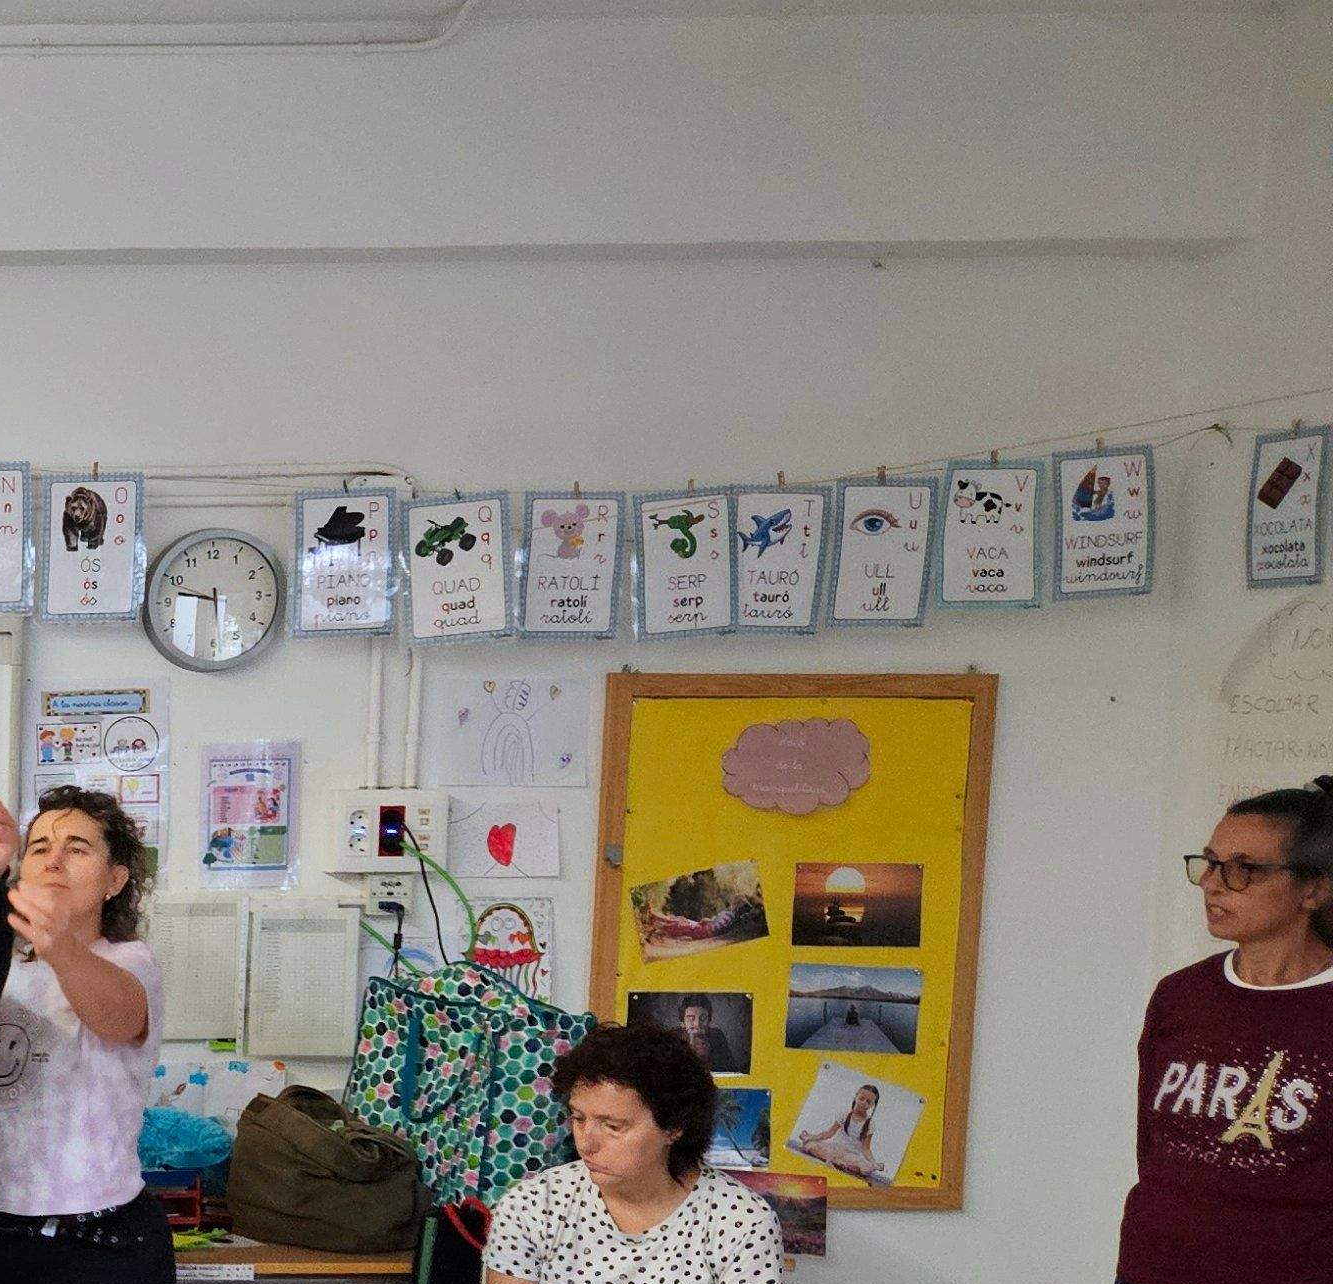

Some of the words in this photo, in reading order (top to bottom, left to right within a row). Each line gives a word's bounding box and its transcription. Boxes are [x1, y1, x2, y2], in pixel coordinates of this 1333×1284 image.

[2, 476, 15, 494] N
[115, 487, 128, 503] O
[1064, 533, 1143, 549] WINDSURF
[1261, 540, 1306, 555] xocolata
[207, 550, 220, 560] 12
[234, 556, 238, 564] 1
[967, 547, 1009, 559] VACA
[81, 556, 101, 573] ÓS
[186, 559, 197, 567] 11
[1076, 553, 1133, 568] windsurf
[249, 570, 255, 579] 2
[747, 568, 800, 585] TAURÓ
[864, 564, 894, 580] ULL
[972, 567, 1005, 579] vaca
[83, 577, 98, 590] ós
[170, 575, 183, 585] 10
[316, 574, 371, 589] PIANO
[432, 577, 480, 593] QUAD
[537, 574, 600, 590] RATOLÍ
[668, 574, 707, 590] SERP
[967, 580, 1007, 594] vaca
[256, 591, 262, 600] 3
[753, 590, 790, 603] tauró
[873, 583, 886, 596] ull
[164, 598, 171, 607] 9
[326, 594, 361, 610] piano
[442, 598, 475, 614] quad
[550, 595, 587, 608] ratolí
[673, 594, 703, 610] serp
[170, 619, 176, 628] 8
[250, 612, 256, 621] 4
[434, 612, 482, 630] quad
[667, 610, 708, 626] serp
[211, 639, 217, 648] 6
